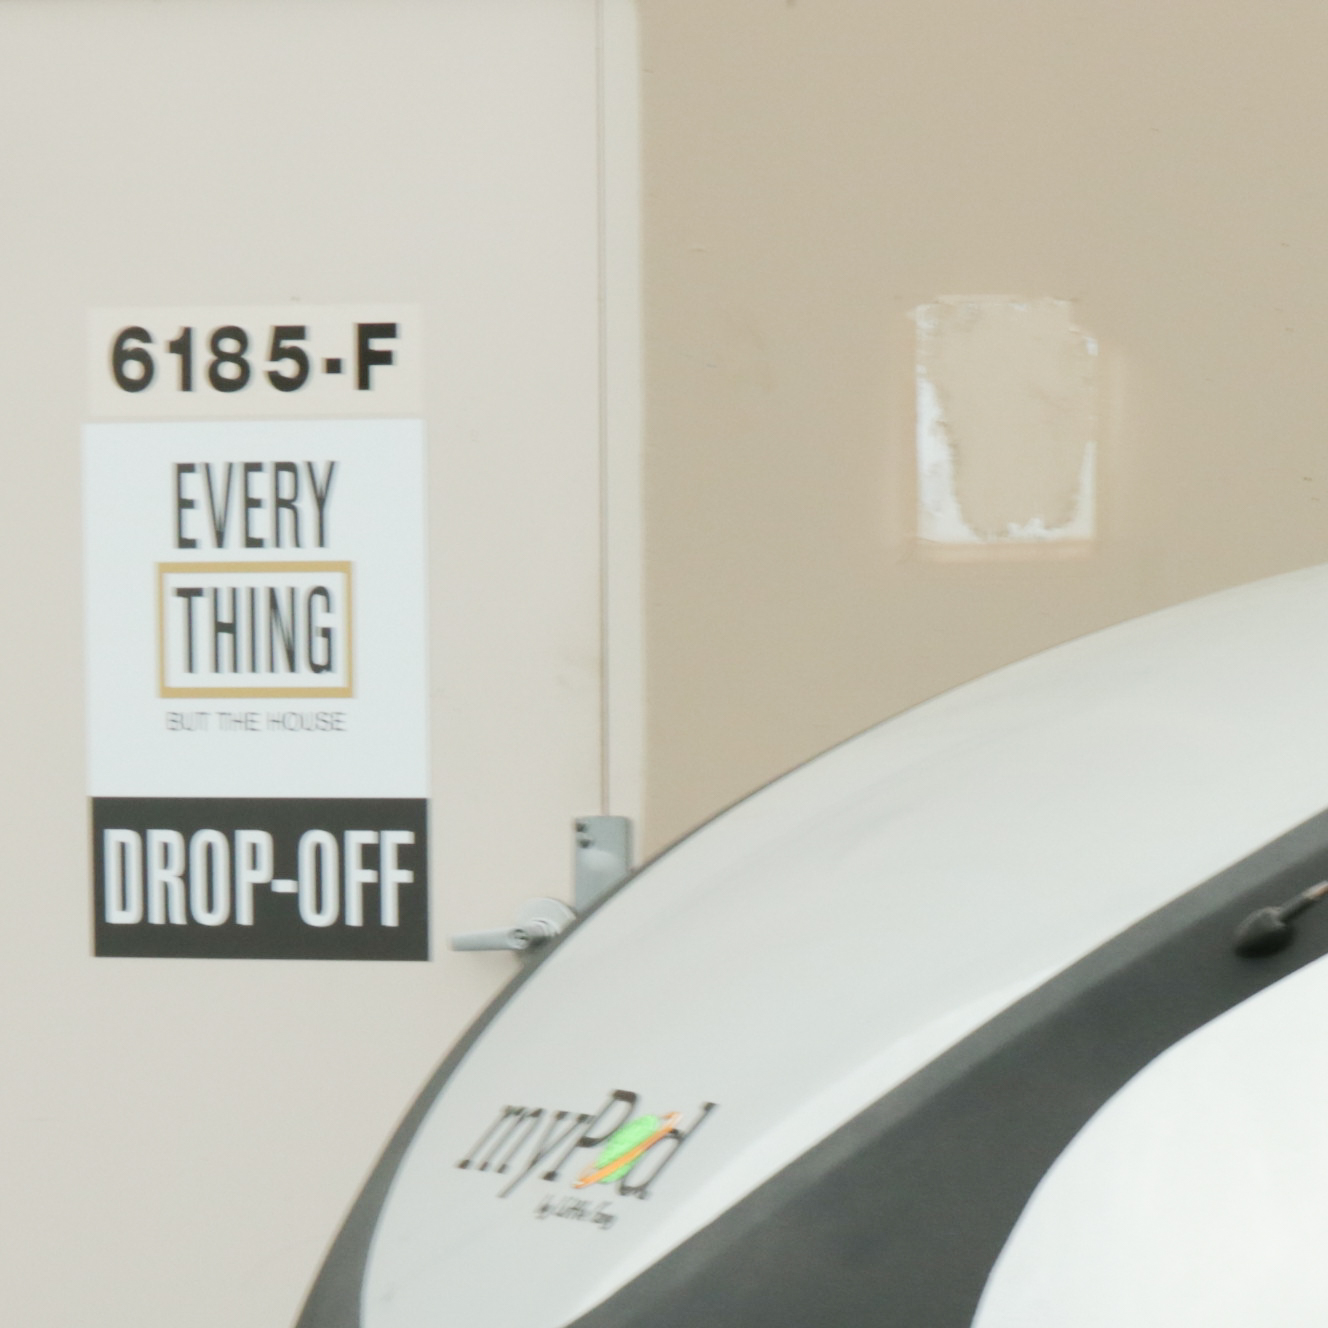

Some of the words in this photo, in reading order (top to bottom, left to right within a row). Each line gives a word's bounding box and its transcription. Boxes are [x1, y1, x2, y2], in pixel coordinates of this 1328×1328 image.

[111, 322, 398, 392] 6185-F
[173, 460, 337, 549] EVERY
[174, 585, 335, 675] THING
[166, 711, 211, 732] BUT
[215, 711, 261, 732] THE
[266, 711, 347, 733] HOUSE
[104, 828, 416, 928] DROP-OFF
